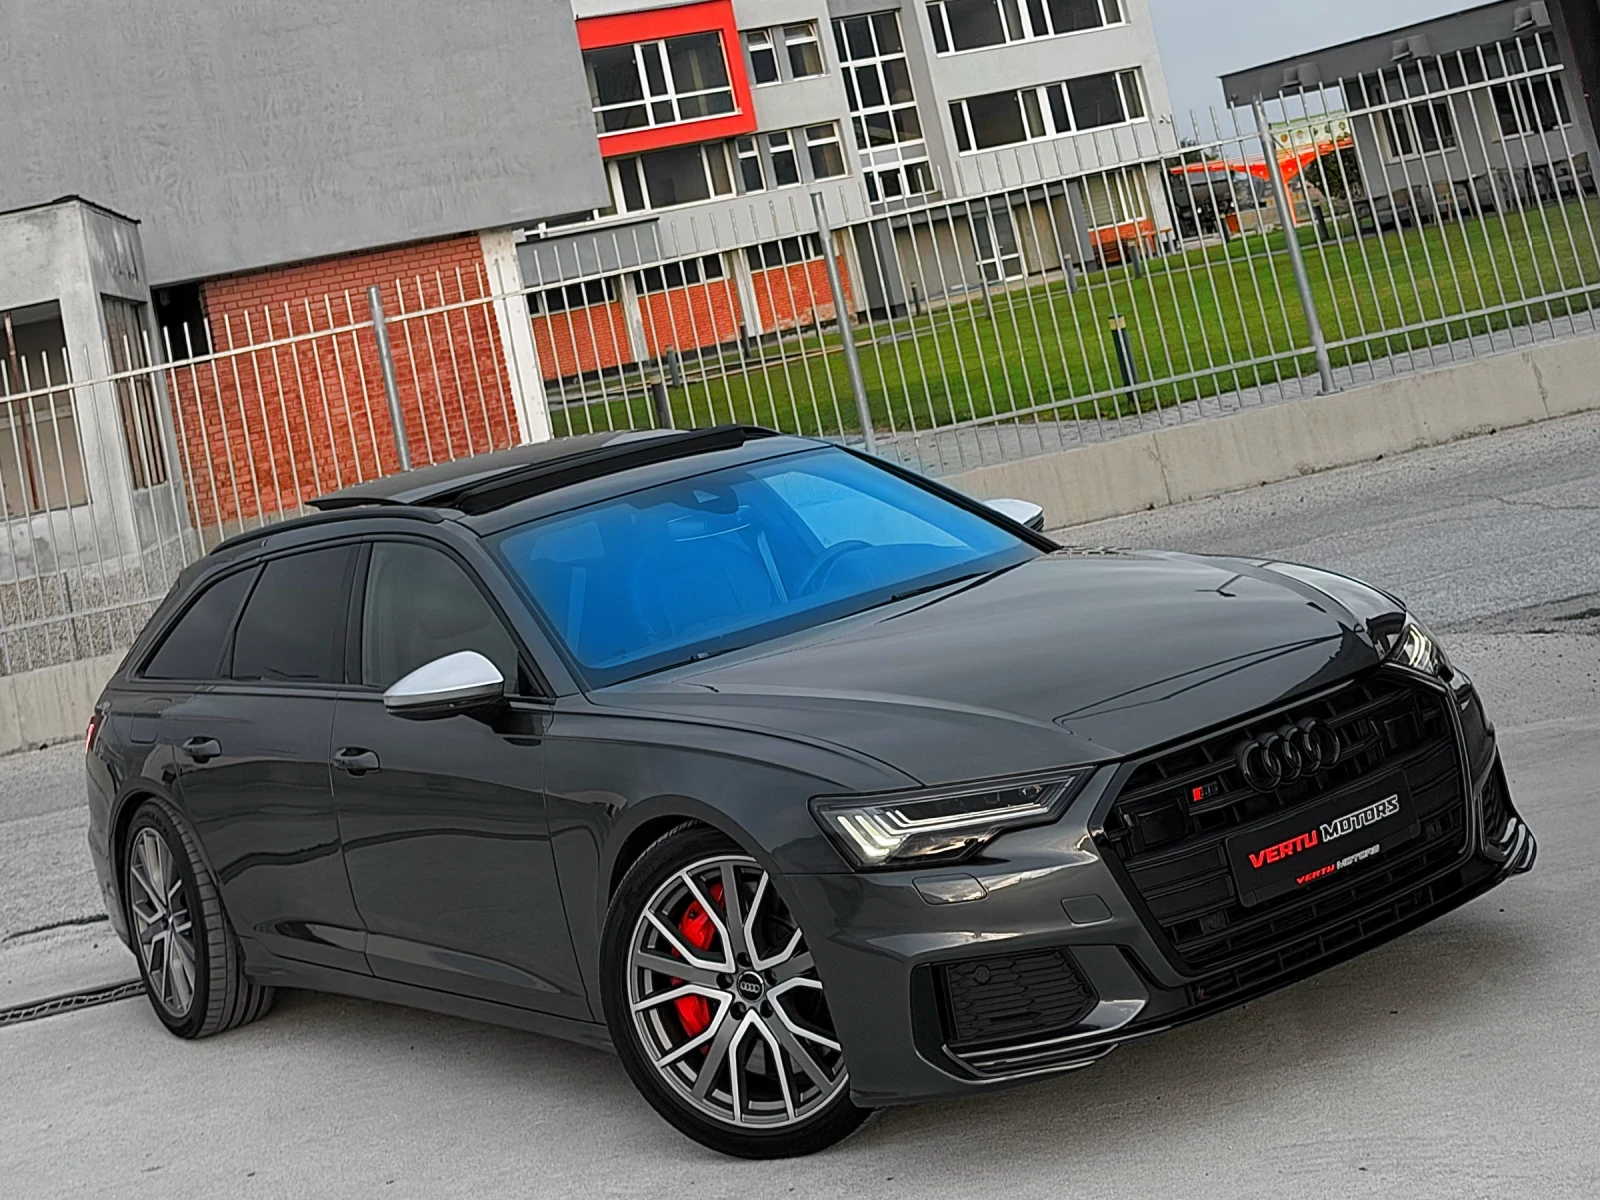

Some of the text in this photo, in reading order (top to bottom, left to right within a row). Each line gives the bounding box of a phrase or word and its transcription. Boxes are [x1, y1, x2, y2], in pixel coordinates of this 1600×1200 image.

[1249, 794, 1399, 868] VERTU MOTORS
[1296, 863, 1335, 884] VERTU
